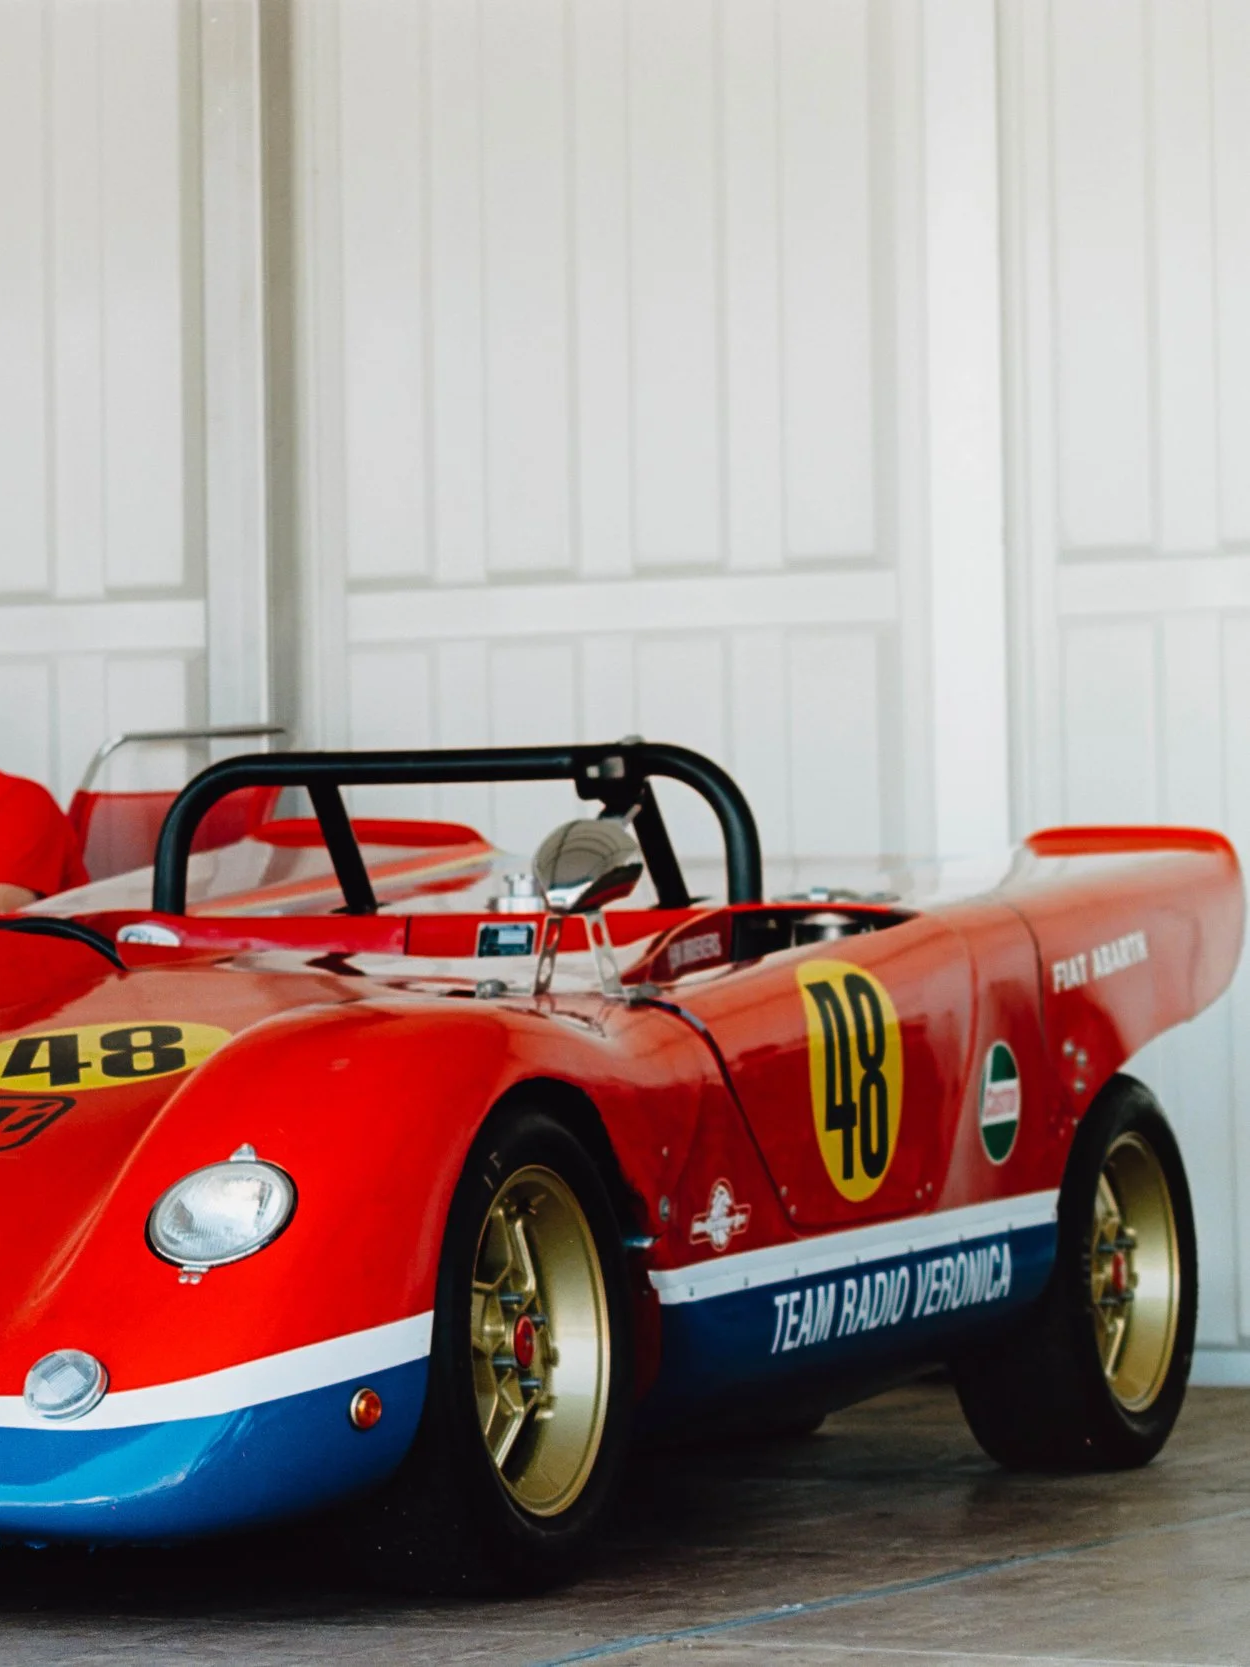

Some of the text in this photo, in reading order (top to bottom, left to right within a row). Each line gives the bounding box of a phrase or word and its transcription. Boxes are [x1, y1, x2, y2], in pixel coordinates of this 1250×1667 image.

[1, 1025, 186, 1087] 48
[804, 973, 888, 1180] 48
[770, 1242, 1012, 1354] TEAM RADIO VERONICA
